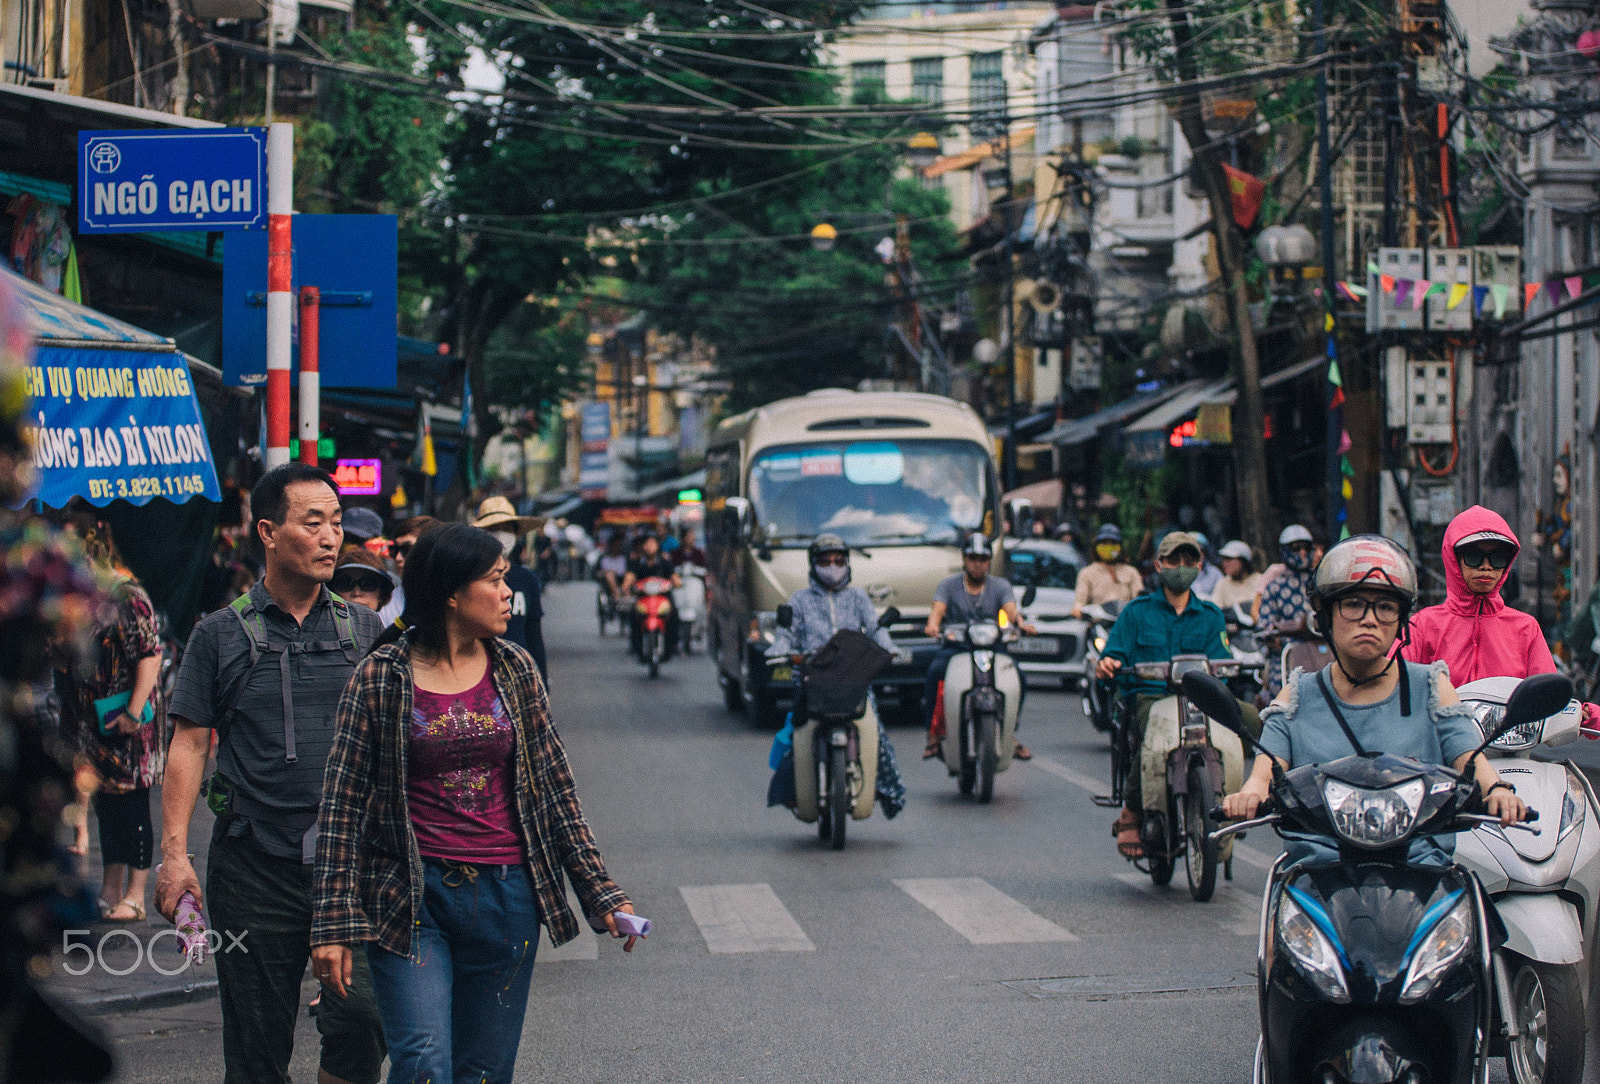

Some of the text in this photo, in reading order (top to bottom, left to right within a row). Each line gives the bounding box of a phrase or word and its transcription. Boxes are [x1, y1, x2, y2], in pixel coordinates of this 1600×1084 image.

[94, 174, 252, 219] NGÕ GẠCH
[47, 366, 73, 404] VỤ
[76, 367, 135, 401] QUANG
[79, 427, 122, 468] BAO
[120, 414, 148, 466] BÌ
[143, 424, 207, 465] NILON
[116, 475, 205, 497] 3.828.1145
